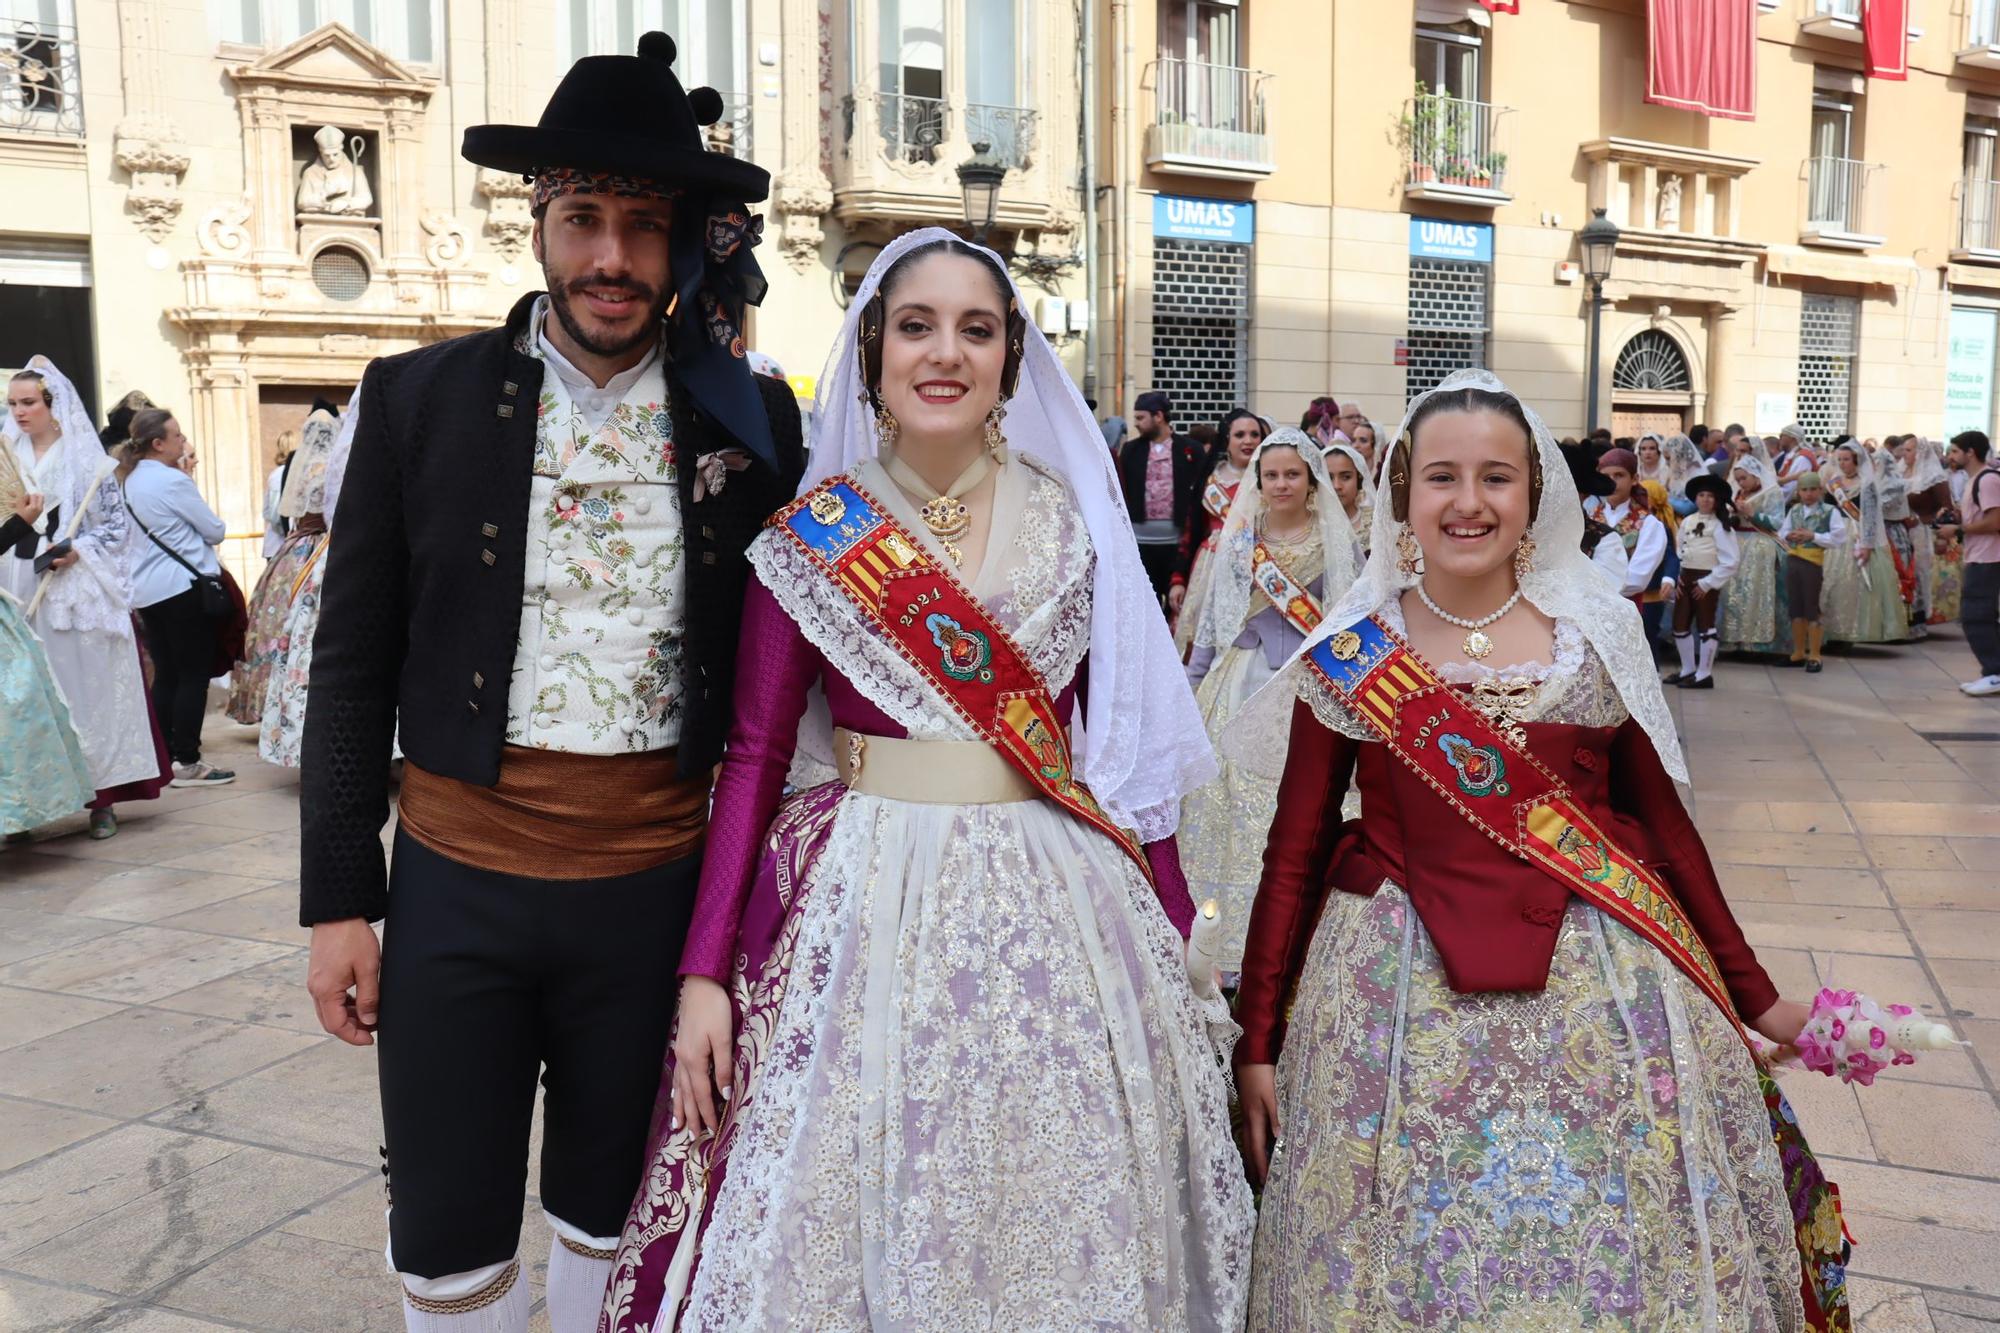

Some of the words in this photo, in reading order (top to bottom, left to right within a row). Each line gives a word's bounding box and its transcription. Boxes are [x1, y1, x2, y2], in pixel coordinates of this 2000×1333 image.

[1167, 199, 1235, 227] UMAS
[1420, 221, 1478, 248] UMAS
[899, 587, 942, 627] 2024
[1414, 707, 1451, 750] 2024
